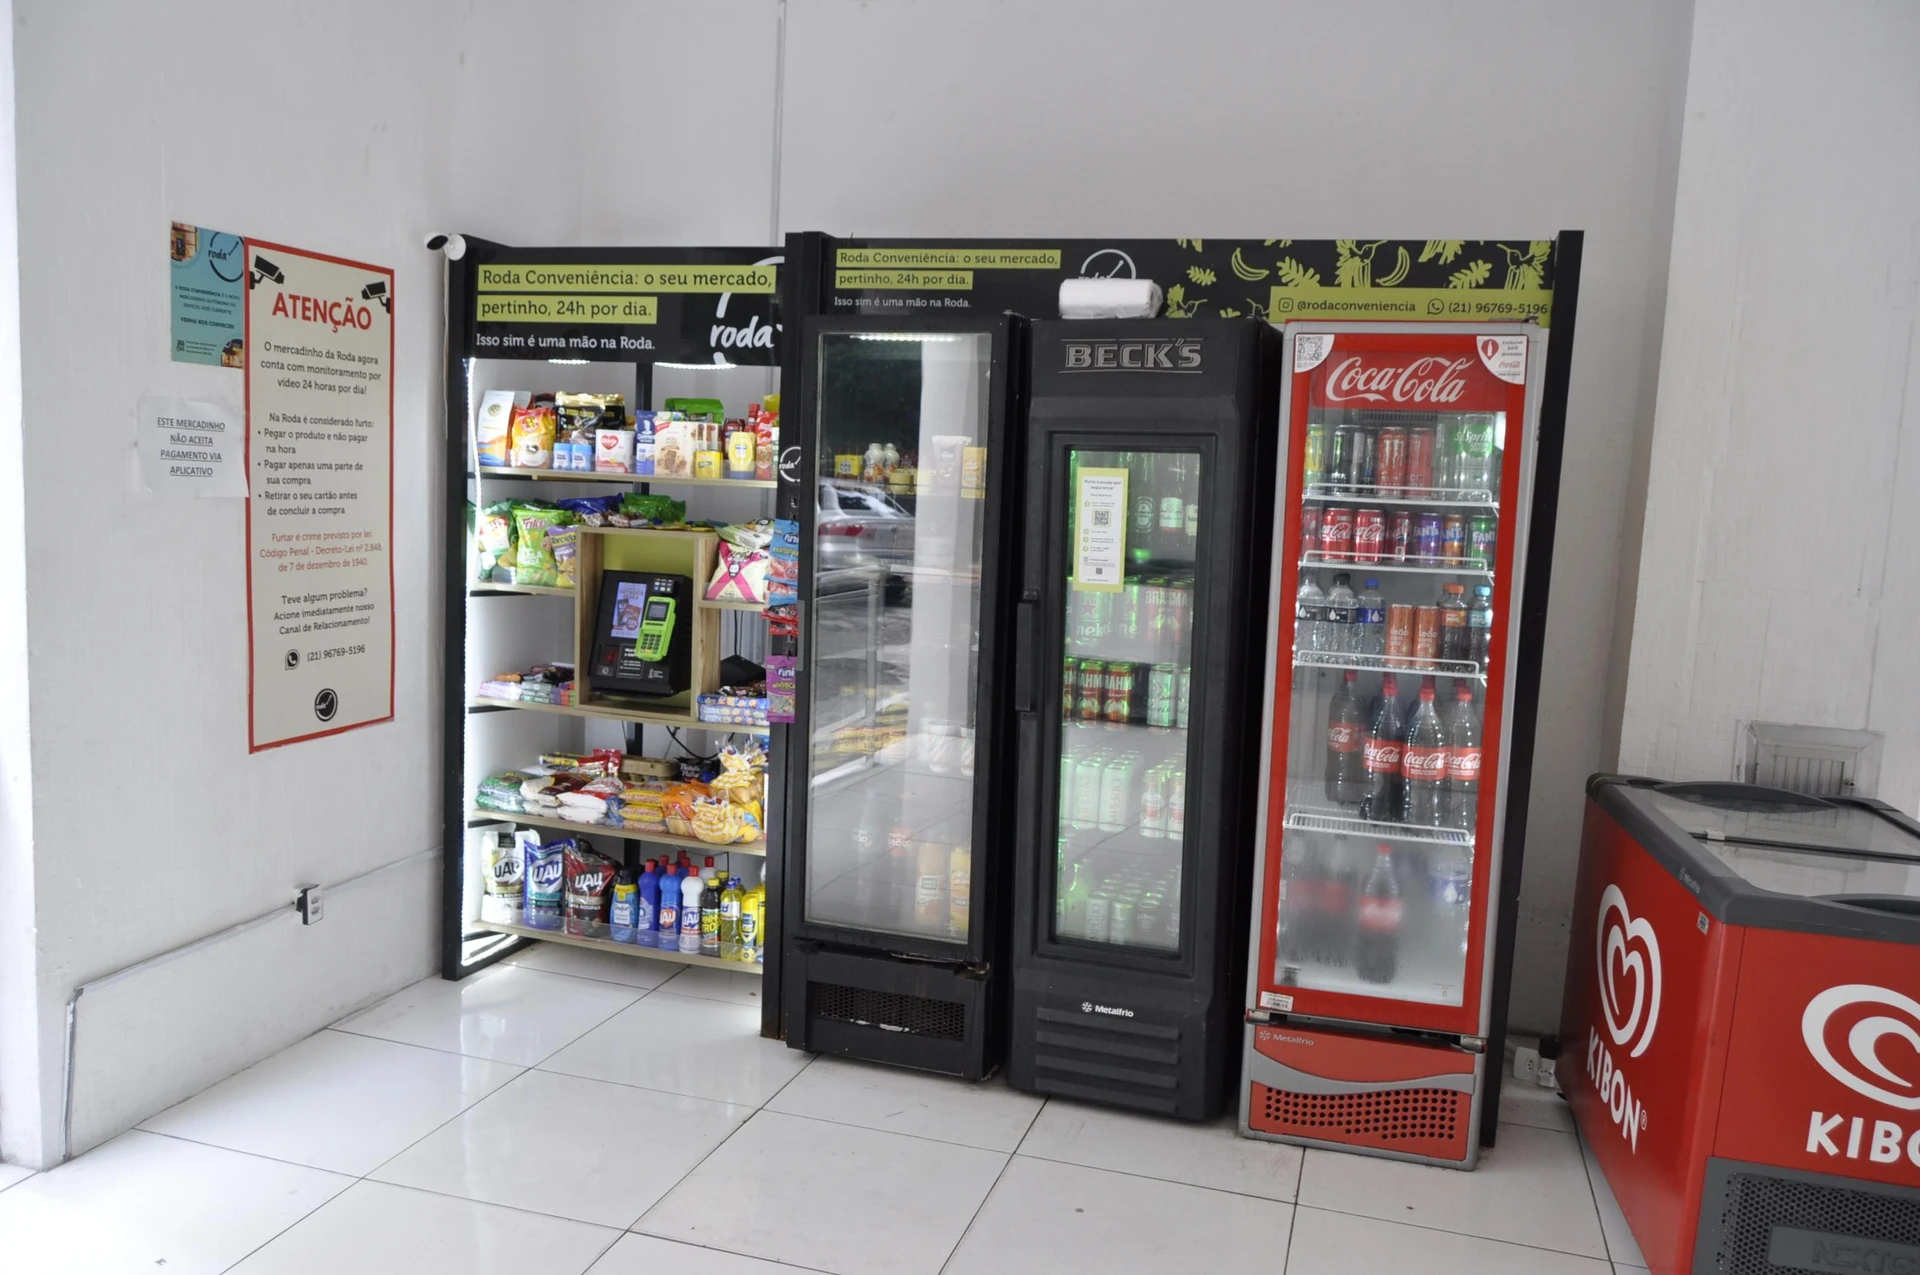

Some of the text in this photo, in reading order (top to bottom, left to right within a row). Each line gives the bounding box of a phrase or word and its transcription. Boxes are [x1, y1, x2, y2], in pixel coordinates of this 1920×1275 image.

[840, 253, 1058, 266] Roda Conveniência: o seu mercado,
[483, 269, 772, 289] Roda Conveniência: o seu mercado,
[839, 273, 969, 289] pertinho, 24h por dia.
[481, 300, 652, 318] pertinho, 24h por dia.
[834, 297, 971, 308] Isso sim é uma mão na Roda.
[1297, 299, 1548, 315] @rodaconveniencia (21) 96769-5196
[272, 292, 372, 334] ATENÇÃO
[709, 315, 776, 349] roda
[476, 333, 656, 350] Isso sim é uma mão na Roda.
[264, 341, 379, 366] O mercadinho da Roda agora
[1065, 340, 1202, 369] BECK'S
[260, 360, 381, 382] conta com monitoramento por
[277, 378, 367, 395] vídeo 24 horas por dia!
[1325, 356, 1476, 403] Coca-Cola
[157, 417, 225, 431] ESTE MERCADINHO
[269, 412, 375, 428] Na Roda é considerado furto:
[170, 433, 213, 445] NÃO ACEITA
[264, 428, 286, 439] Pegar
[295, 431, 326, 440] produto
[333, 432, 347, 441] não
[348, 434, 368, 444] pagar
[160, 449, 222, 461] PAGAMENTO VIA
[266, 445, 296, 454] na hora
[170, 466, 213, 476] APLICATIVO
[264, 460, 363, 472] Pagar apenas uma parte de
[282, 477, 311, 486] compra
[264, 491, 358, 500] Retirar o seu cartão antes
[267, 506, 277, 515] de
[279, 506, 310, 515] concluir
[318, 507, 345, 516] compra
[271, 533, 294, 542] Furtar
[295, 532, 300, 541] é
[302, 532, 322, 541] crime
[323, 531, 350, 541] previsto
[351, 531, 363, 540] por
[1473, 532, 1495, 542] FANT
[259, 548, 288, 560] Código
[289, 547, 309, 556] Penal
[315, 545, 354, 555] Decreto-Lei
[278, 563, 288, 572] de
[289, 562, 294, 571] 7
[295, 562, 305, 571] de
[306, 560, 341, 570] dezembro
[342, 559, 351, 568] de
[281, 588, 368, 605] Teve algum problema?
[273, 603, 375, 621] Acione imediatamente nosso
[279, 616, 371, 635] Canal de Relacionamento!
[307, 644, 366, 662] (21) 96769-5196
[532, 860, 562, 882] UAU
[574, 872, 603, 888] UAU
[1095, 1004, 1134, 1017] Metalfrio
[1272, 1033, 1314, 1046] Metalfrio
[1586, 1025, 1641, 1155] KIBON
